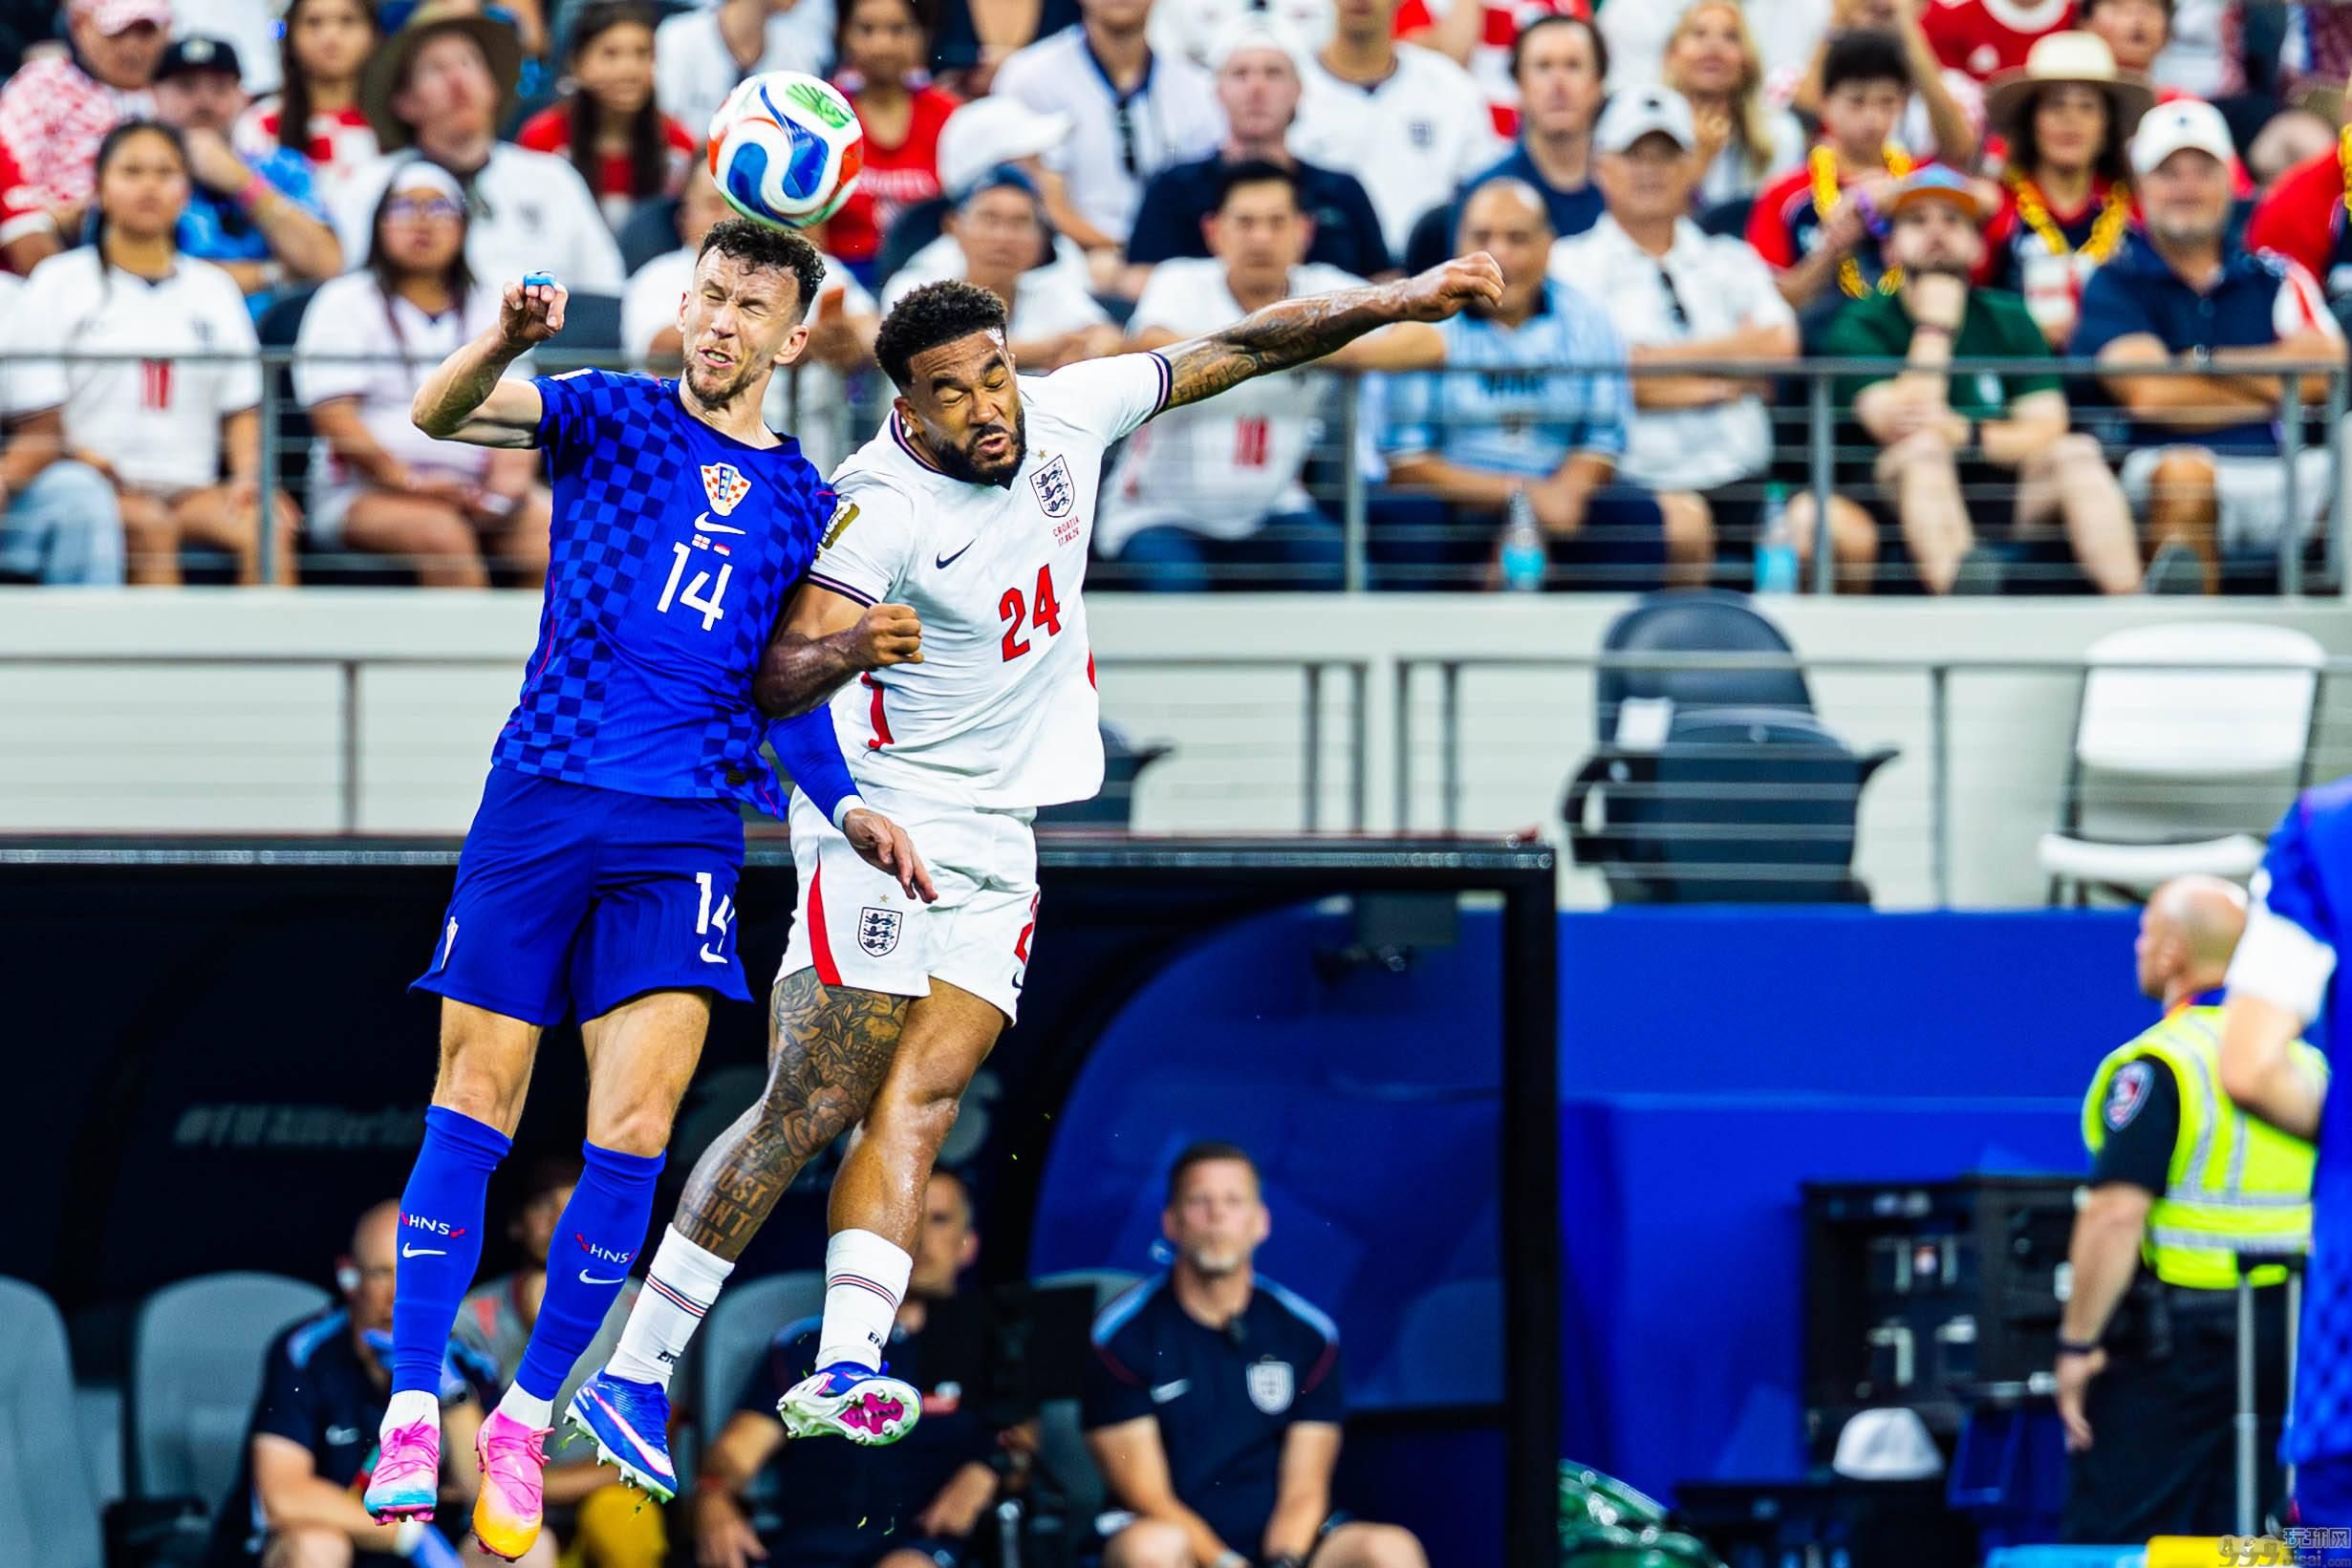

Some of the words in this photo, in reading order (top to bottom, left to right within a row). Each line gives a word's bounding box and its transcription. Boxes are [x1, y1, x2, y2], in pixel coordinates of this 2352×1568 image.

[1053, 516, 1079, 537] CROATIA
[657, 541, 733, 632] 14
[999, 563, 1062, 662] 24
[711, 1160, 768, 1209] JUST
[408, 1214, 451, 1235] HNS
[590, 1243, 629, 1264] HNS
